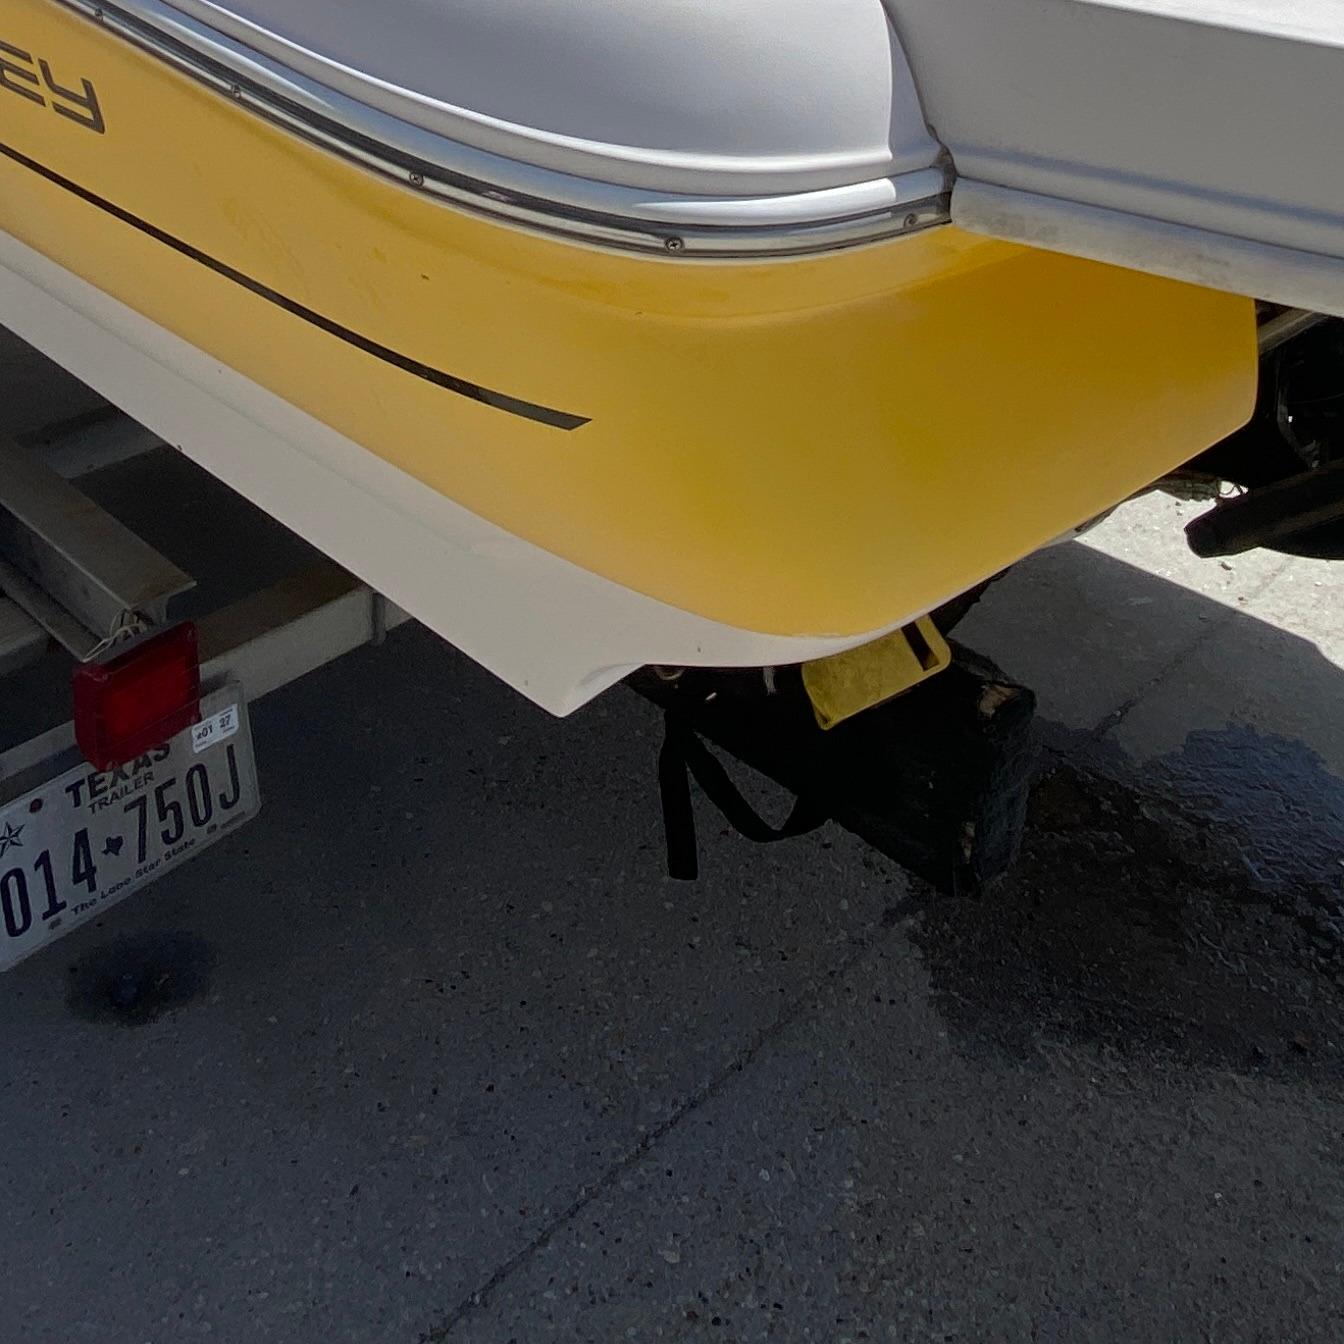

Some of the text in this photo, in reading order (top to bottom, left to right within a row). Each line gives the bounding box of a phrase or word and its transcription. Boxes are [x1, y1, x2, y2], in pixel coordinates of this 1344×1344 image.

[65, 743, 170, 808] TEXAS
[88, 771, 155, 814] TRAILER
[71, 839, 195, 915] The Lone Star State
